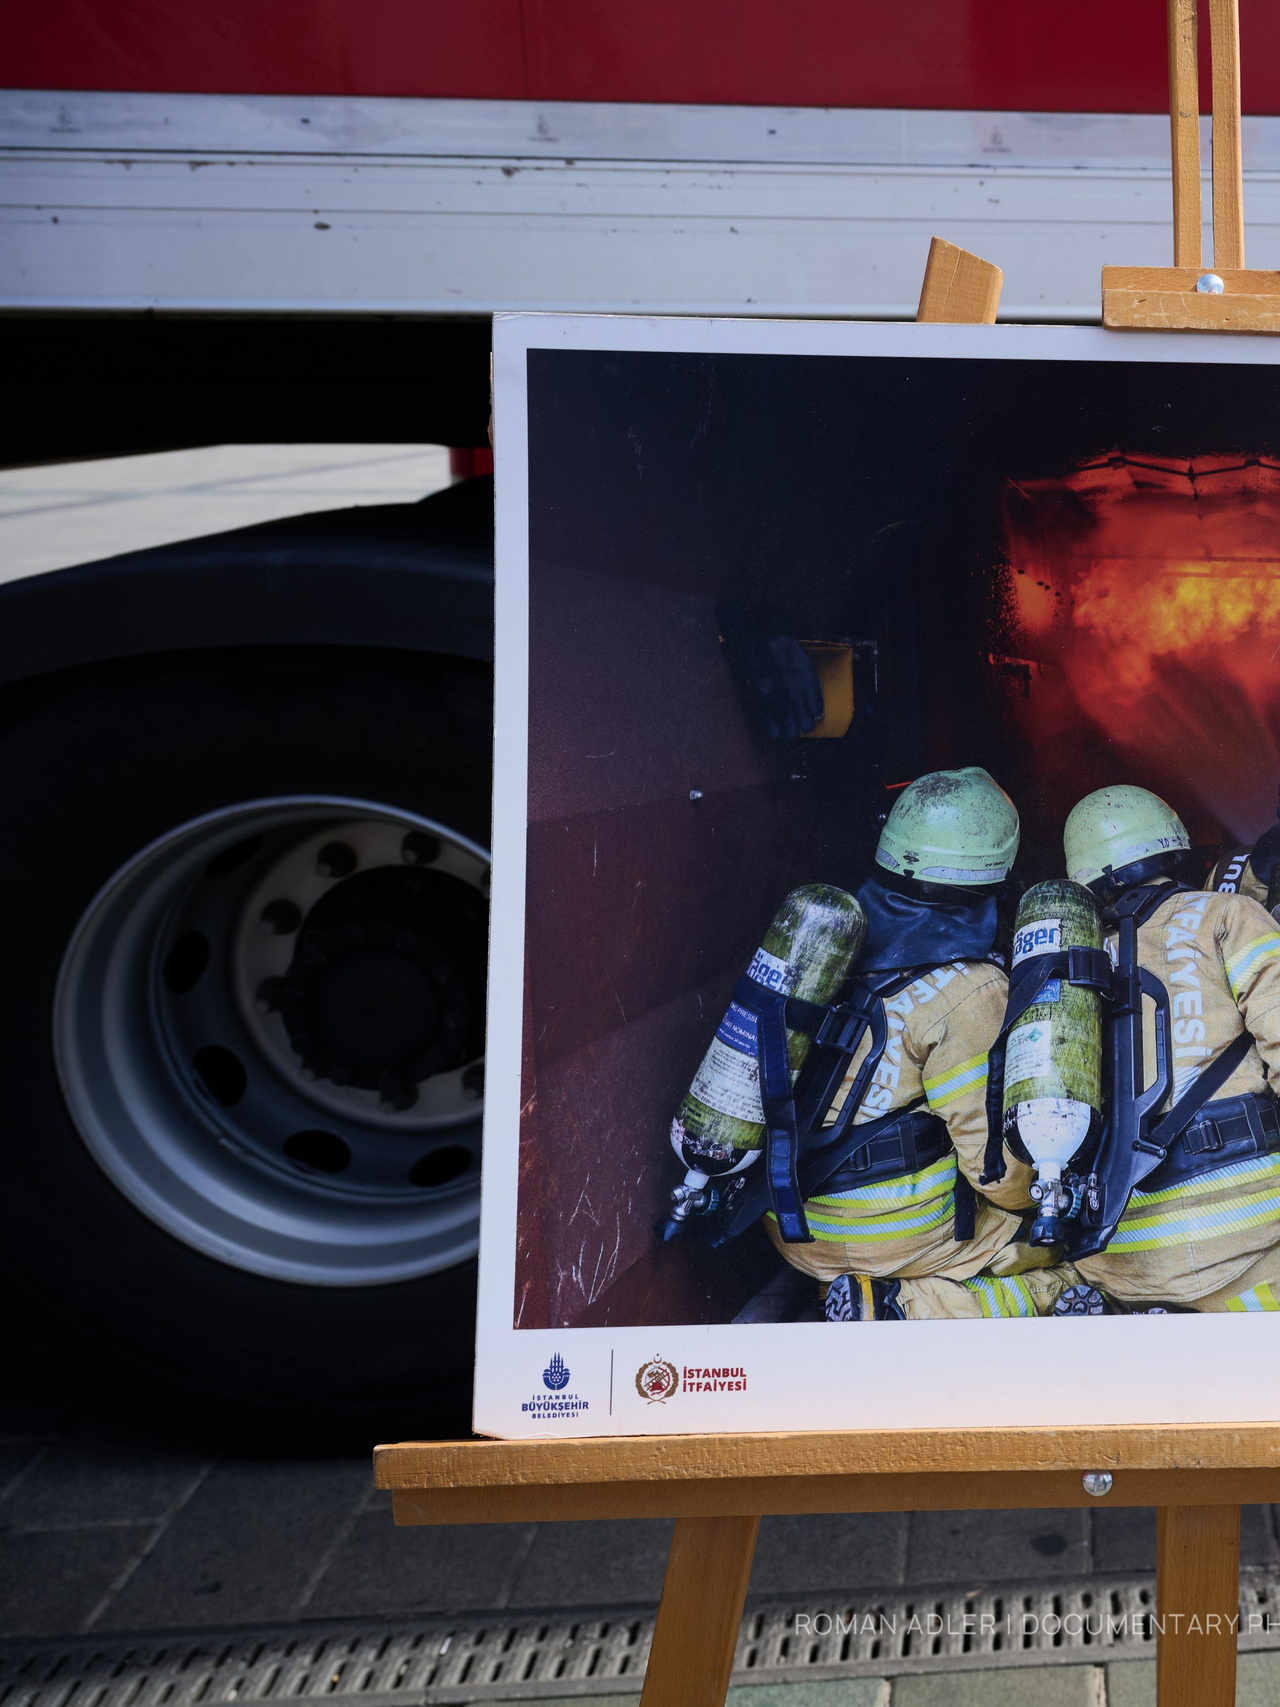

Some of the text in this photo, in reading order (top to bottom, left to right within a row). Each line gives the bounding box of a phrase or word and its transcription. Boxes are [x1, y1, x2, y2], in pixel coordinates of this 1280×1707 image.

[682, 1366, 747, 1379] İSTANBUL
[682, 1378, 747, 1393] İTFAİYESİ
[521, 1400, 589, 1412] BÜYÜKŞEHİR
[531, 1411, 579, 1419] BELEDİYESİ
